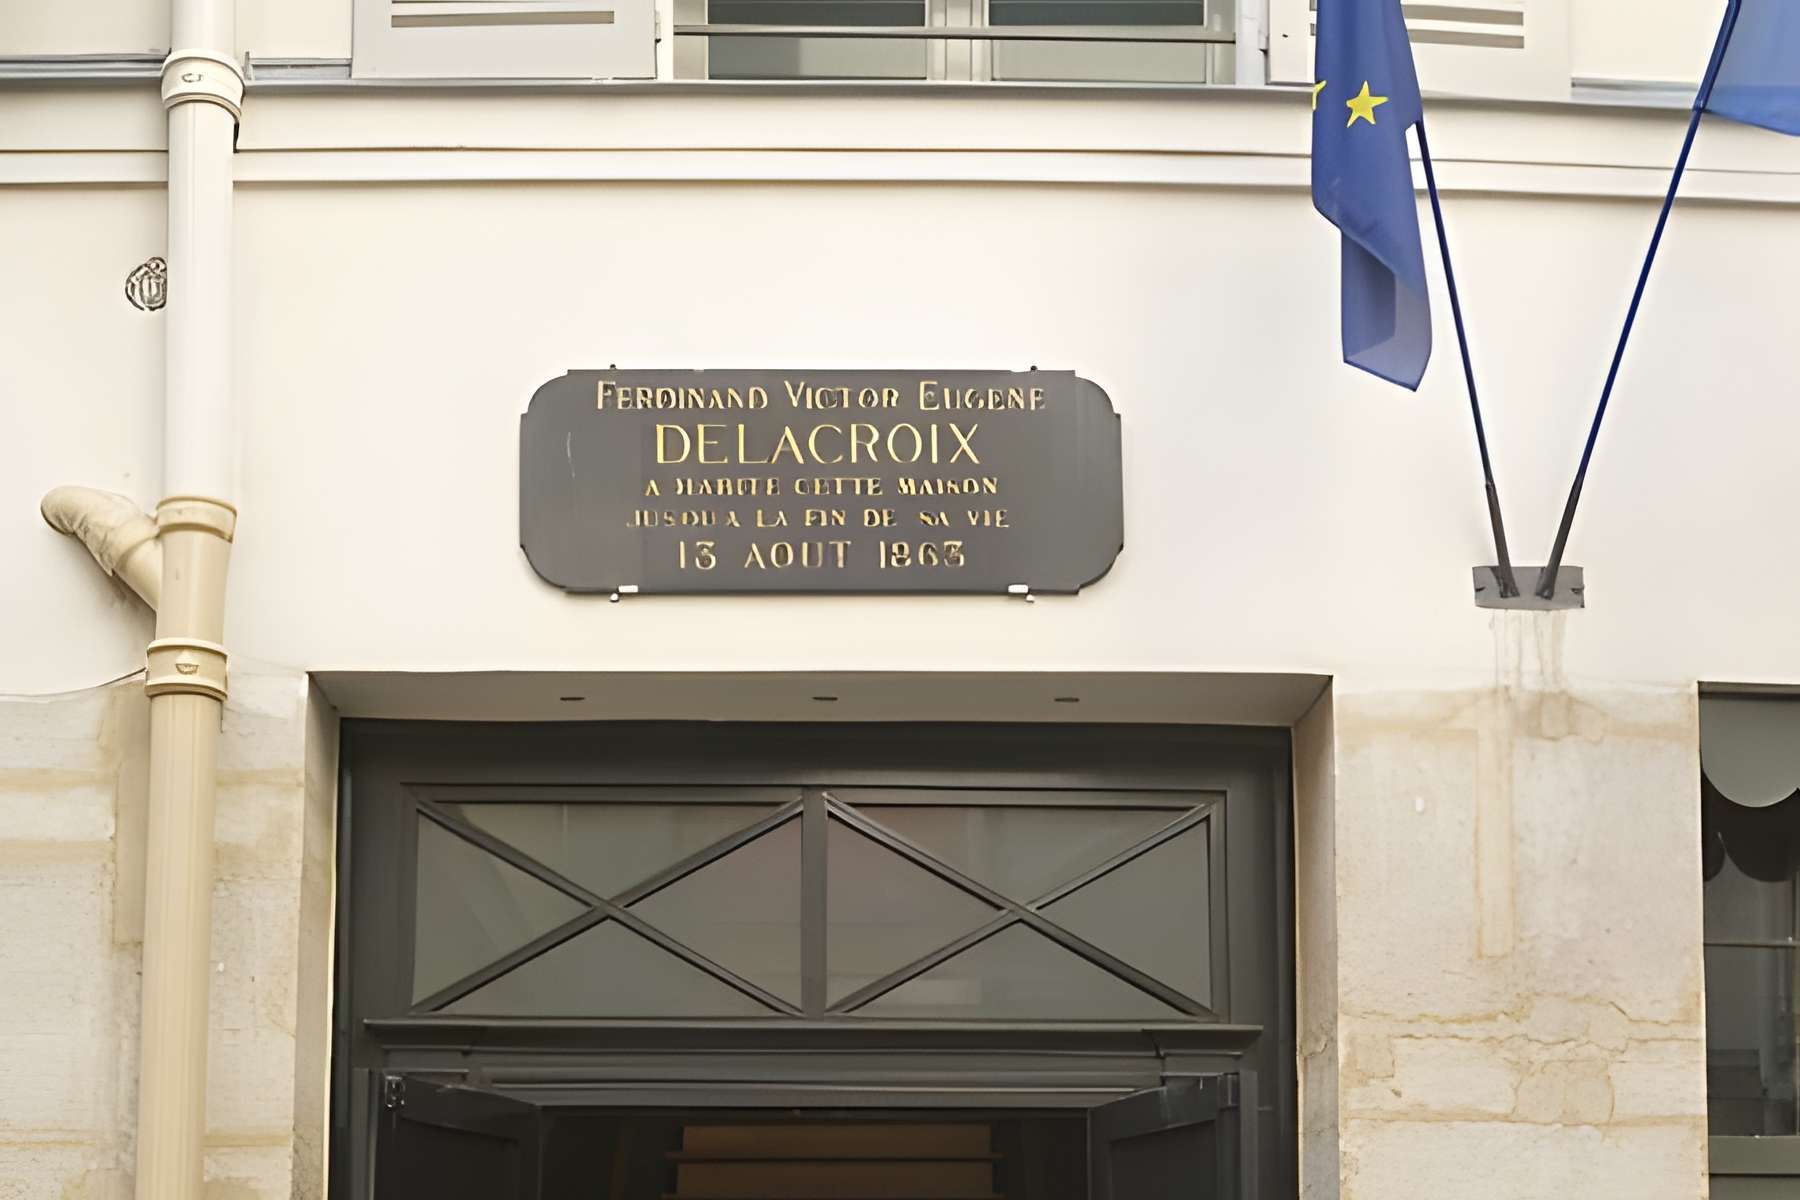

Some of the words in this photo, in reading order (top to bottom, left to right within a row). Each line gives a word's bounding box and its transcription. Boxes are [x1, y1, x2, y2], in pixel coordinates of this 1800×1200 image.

[783, 380, 899, 410] VICTOR
[656, 423, 980, 464] DELACROIX
[645, 479, 661, 497] A
[756, 509, 788, 528] LA
[863, 508, 897, 527] DE
[967, 509, 1010, 528] VIE
[679, 540, 717, 570] 13
[744, 541, 852, 570] AOUT
[879, 541, 965, 569] 1863
